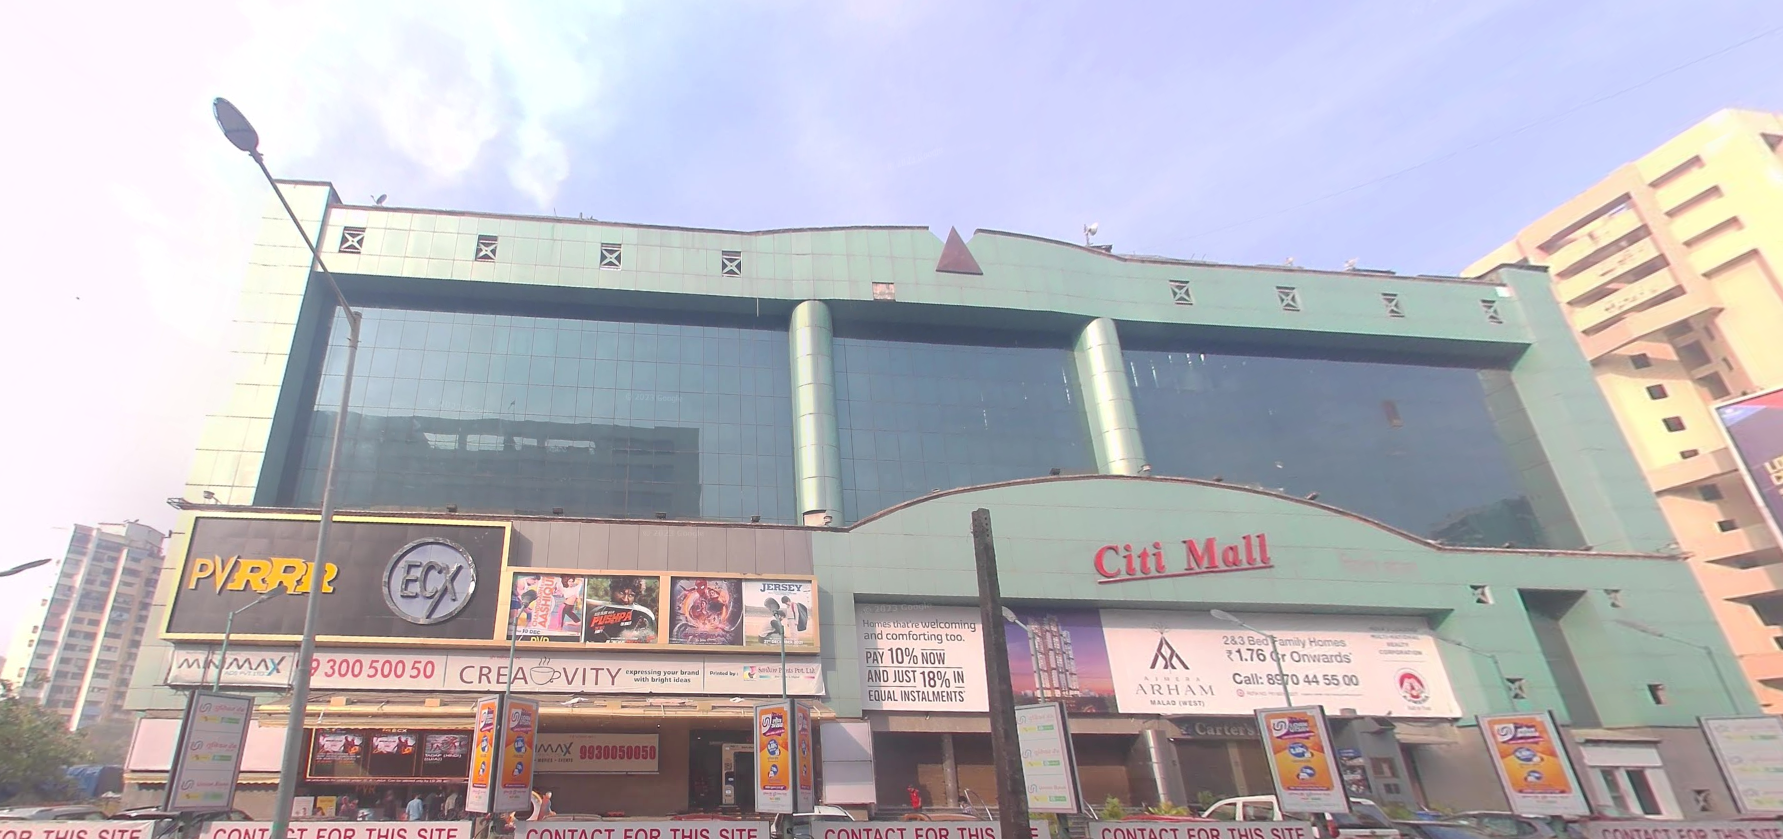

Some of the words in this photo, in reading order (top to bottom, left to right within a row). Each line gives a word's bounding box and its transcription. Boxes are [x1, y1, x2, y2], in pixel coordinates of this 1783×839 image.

[1094, 541, 1166, 578] Citi
[1182, 533, 1270, 570] Mall
[399, 559, 463, 619] ECX
[760, 583, 803, 592] JERSEY
[590, 611, 633, 627] PUSHPA
[862, 619, 891, 629] Homes
[892, 620, 920, 629] that're
[920, 619, 976, 632] welcoming
[863, 631, 884, 641] and
[885, 631, 944, 644] comforting
[945, 633, 966, 642] too.
[1222, 635, 1246, 646] 2&3
[1247, 635, 1270, 646] Bed
[1308, 637, 1347, 648] Homes
[865, 651, 885, 664] PAY
[888, 647, 919, 665] 10%
[921, 651, 946, 665] NOW
[178, 656, 286, 676] MINMAX
[324, 658, 363, 678] 300
[367, 659, 406, 679] 500
[409, 660, 436, 680] 50
[625, 669, 661, 677] expressing
[867, 669, 889, 683] AND
[893, 669, 917, 683] JUST
[919, 670, 951, 689] 18%
[953, 670, 965, 684] IN
[1232, 672, 1264, 685] Call:
[1303, 673, 1320, 686] 44
[1322, 674, 1340, 686] 55
[1342, 674, 1359, 687] 00
[651, 676, 672, 684] bright
[868, 689, 899, 702] EQUAL
[1136, 683, 1216, 696] ARHAM
[1194, 722, 1255, 736] Carter's
[579, 745, 657, 760] 9930050050
[42, 829, 88, 839] THIS
[98, 829, 142, 839] SITE
[212, 828, 309, 839] CONTCT
[316, 828, 356, 839] FOR
[365, 828, 408, 839] THIS
[417, 828, 458, 839] SITE
[526, 828, 615, 839] CONTACT
[624, 828, 661, 839] FOR
[670, 828, 710, 839] THIS
[719, 828, 758, 839] SITE
[825, 827, 907, 839] CONTACT
[915, 827, 949, 839] FOR
[957, 827, 994, 839] THIS
[1101, 827, 1178, 839] CONTACT
[1186, 827, 1220, 839] FOR
[1230, 827, 1264, 839] THIS
[1271, 827, 1305, 839] SITE
[1602, 828, 1674, 839] CONTACT
[1682, 828, 1707, 839] FOR
[1712, 828, 1744, 839] THIS
[1750, 828, 1782, 839] SITE
